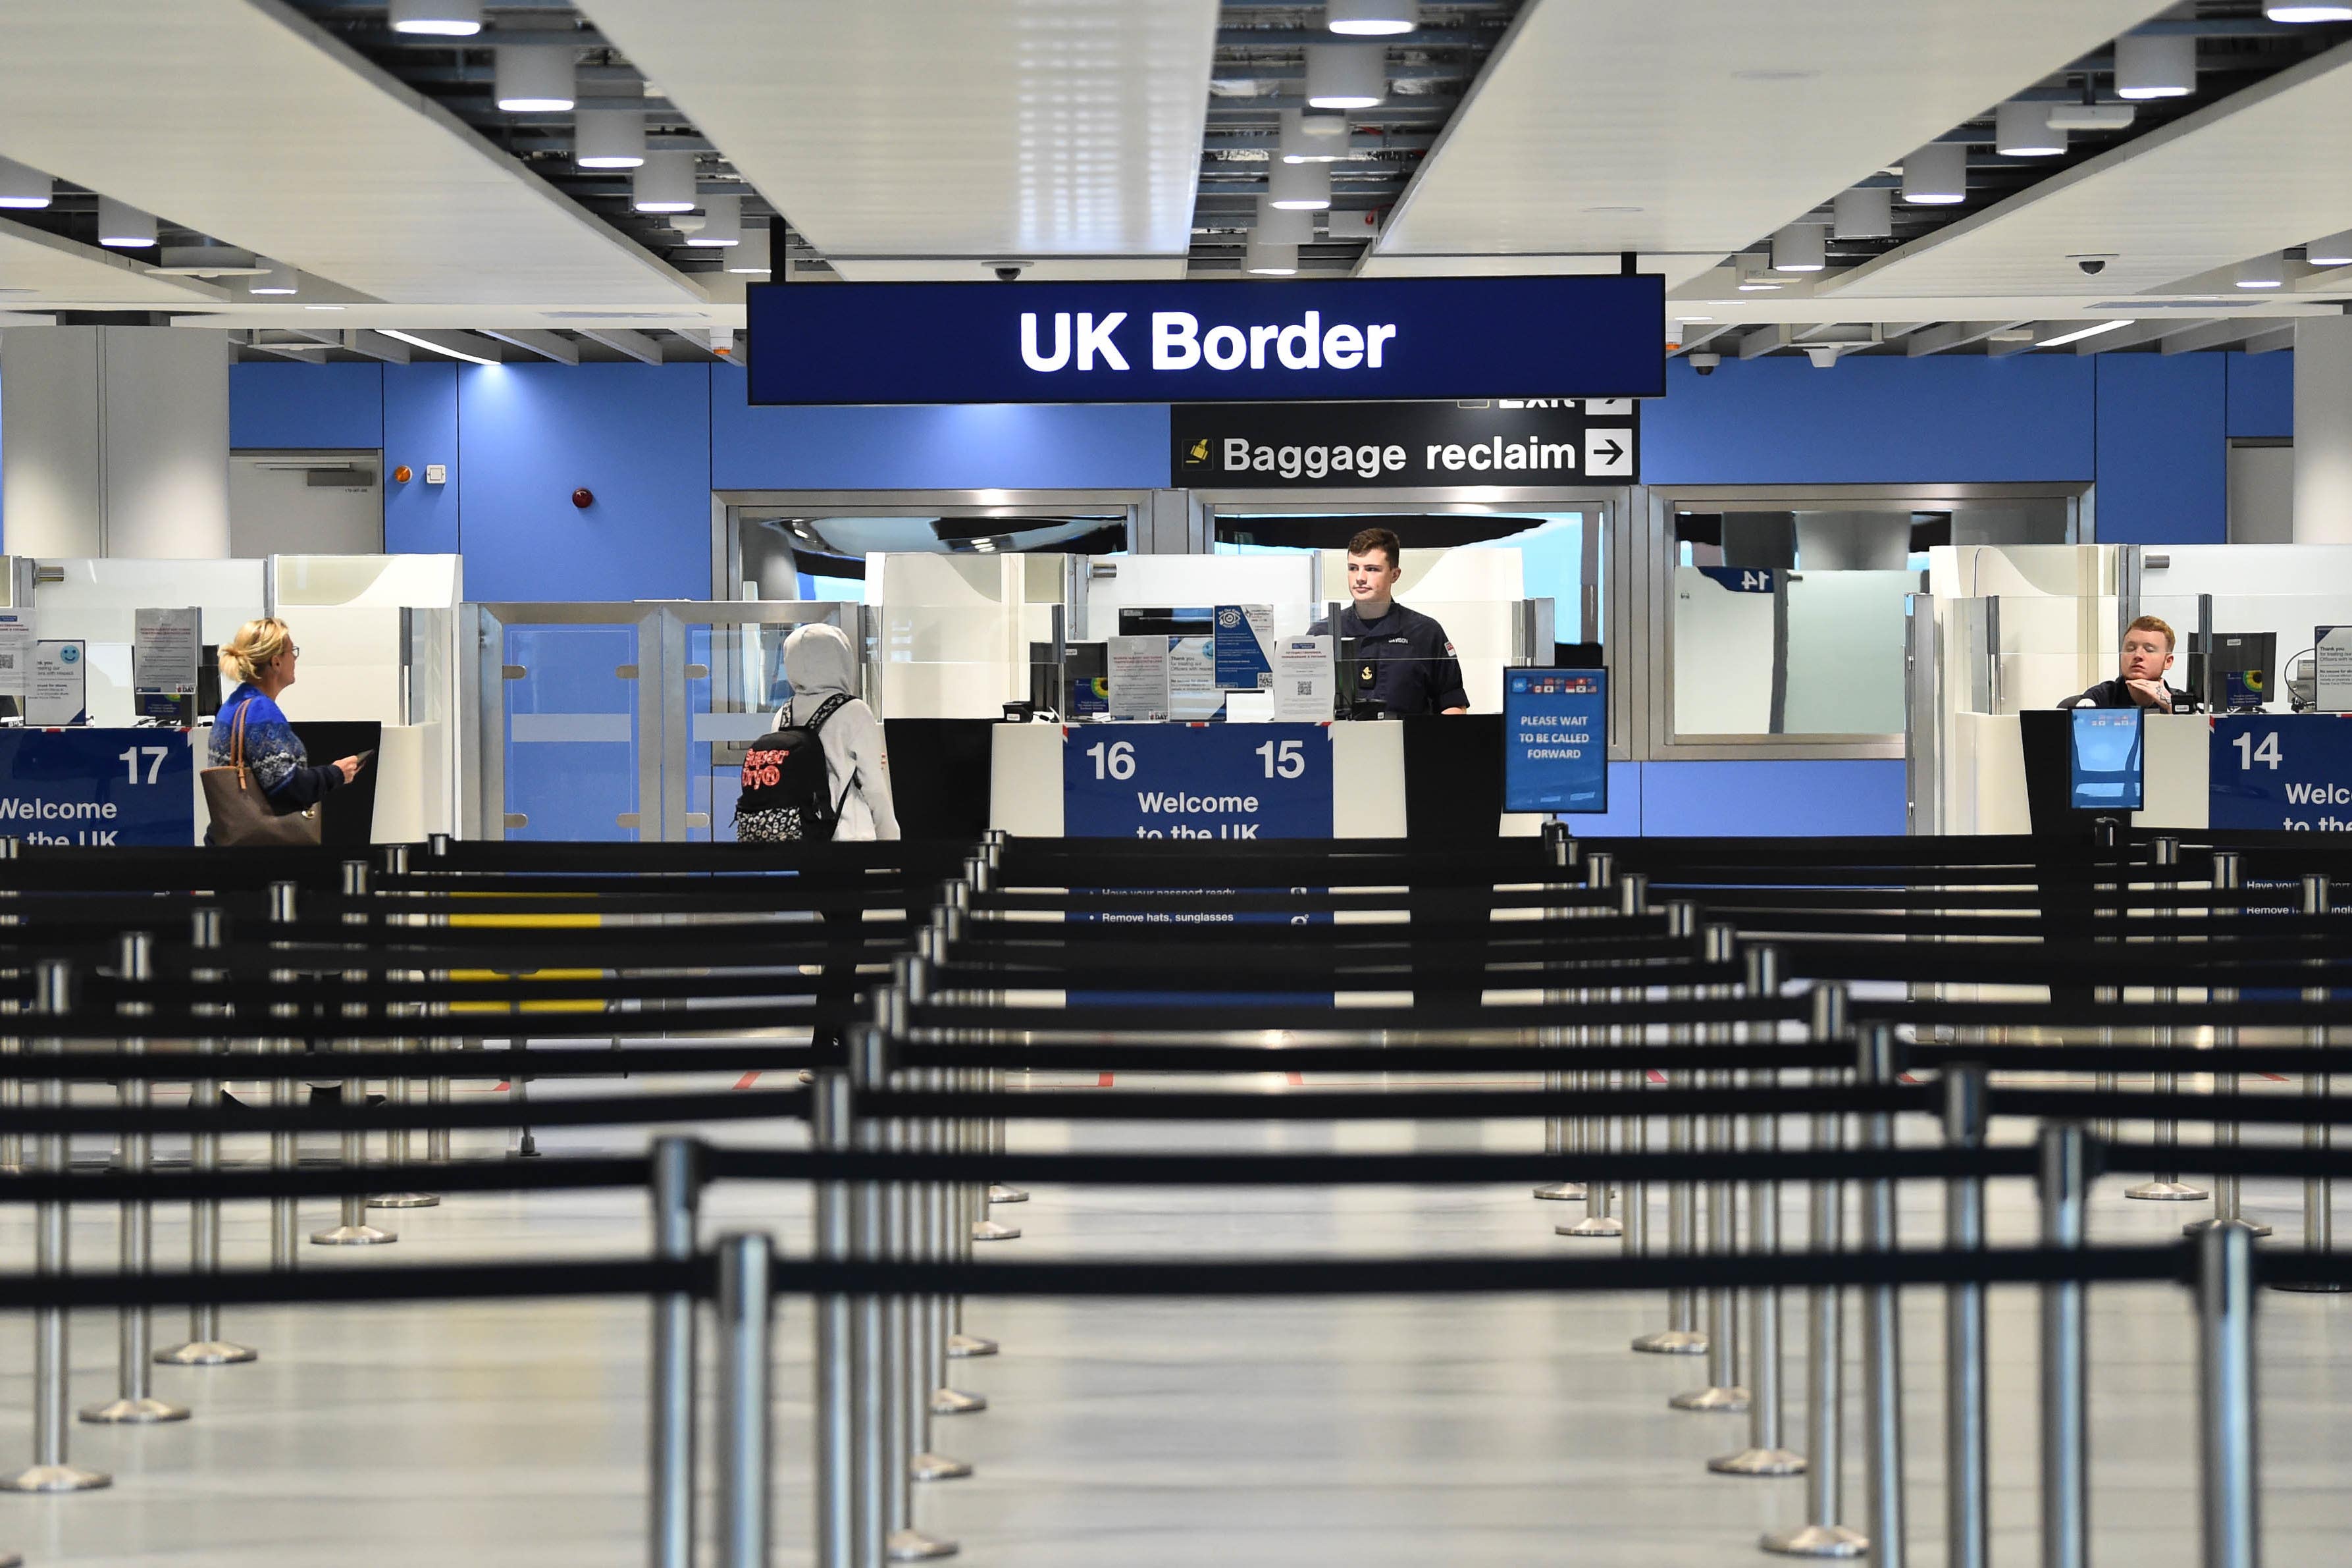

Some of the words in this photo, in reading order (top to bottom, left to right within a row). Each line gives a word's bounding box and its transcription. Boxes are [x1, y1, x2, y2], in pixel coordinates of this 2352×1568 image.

[1020, 312, 1130, 373] UK
[1152, 311, 1396, 370] Border
[1223, 438, 1407, 479] Baggage
[1426, 436, 1576, 471] reclaim
[1521, 716, 1557, 726] PLEASE
[1559, 716, 1588, 726] WAIT
[1519, 733, 1534, 743] TO
[1536, 733, 1550, 743] BE
[1552, 733, 1590, 743] CALLED
[1086, 741, 1136, 780] 16
[1255, 740, 1305, 779] 15
[1527, 749, 1581, 759] FORWARD
[2232, 731, 2283, 770] 14
[118, 746, 169, 785] 17
[1137, 792, 1259, 814] Welcome
[2285, 783, 2352, 804] Welc
[0, 798, 117, 819] Welcome
[79, 831, 118, 846] UK
[1171, 825, 1212, 839] the
[1221, 824, 1261, 839] UK
[1102, 913, 1144, 922] Remove
[1147, 912, 1172, 923] hats,
[1175, 912, 1234, 924] sunglasses
